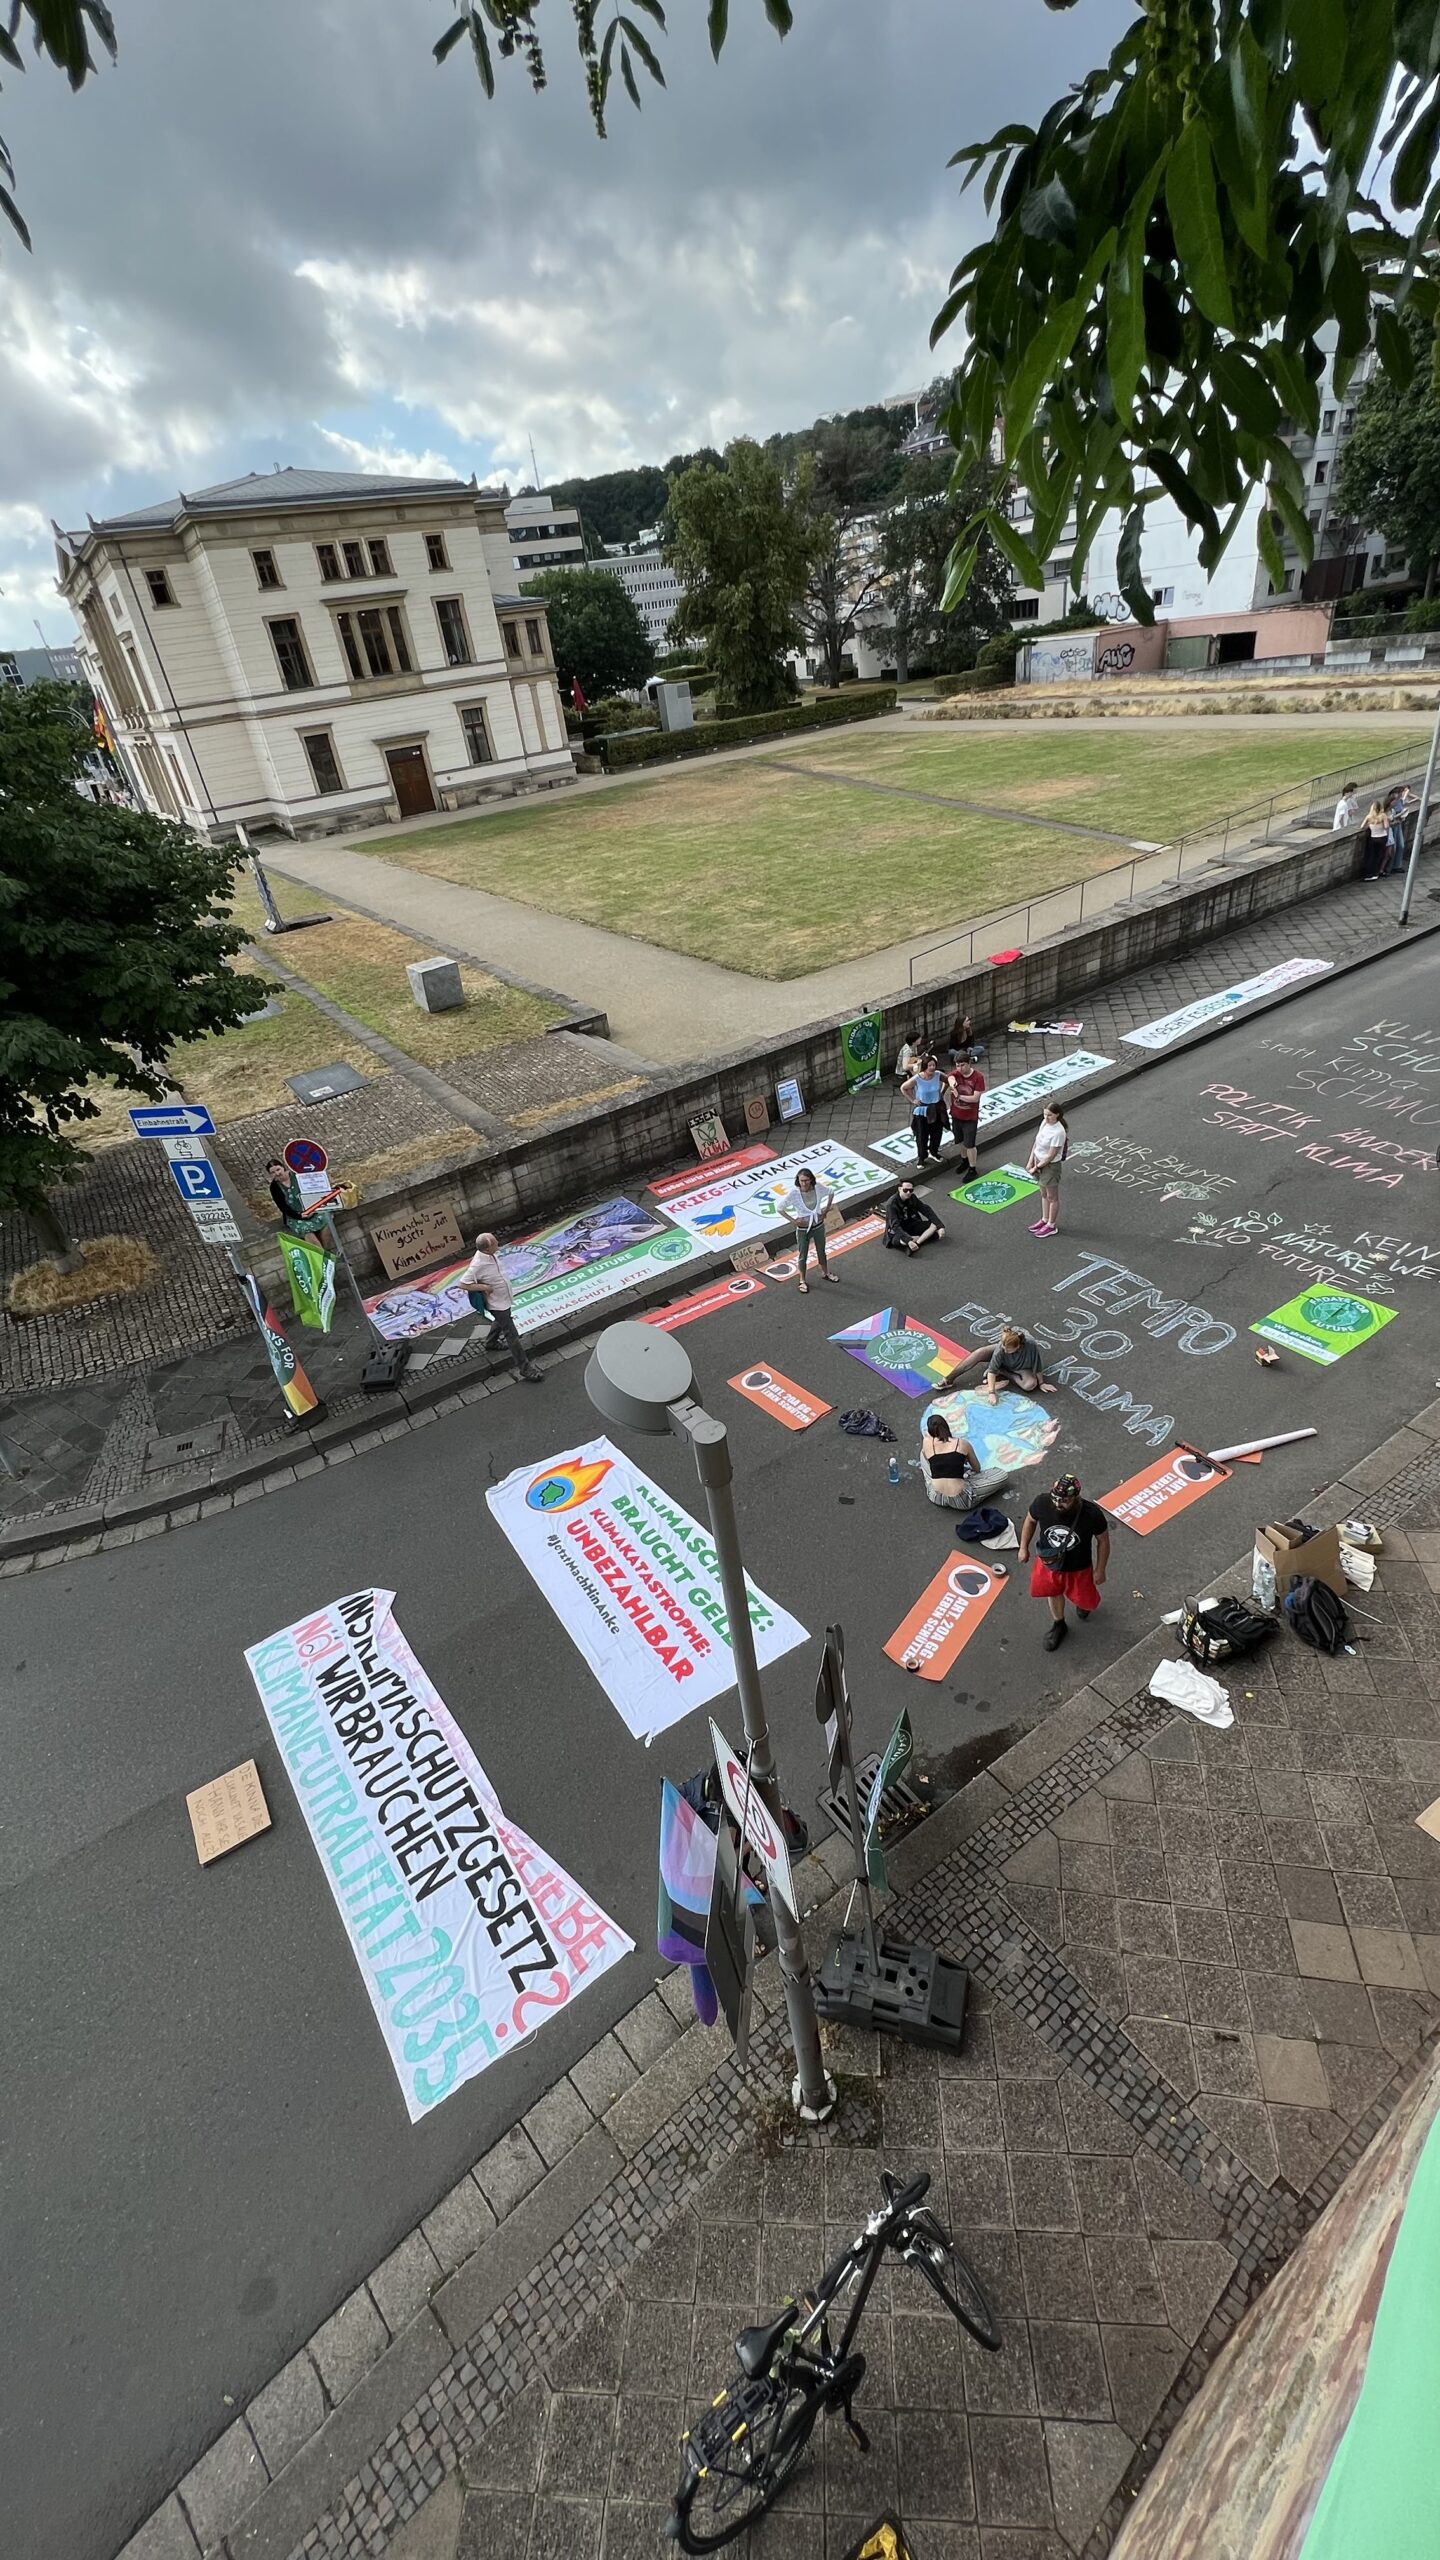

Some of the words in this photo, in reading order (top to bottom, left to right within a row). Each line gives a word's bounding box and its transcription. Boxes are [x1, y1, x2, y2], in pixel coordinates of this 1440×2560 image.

[987, 1068, 1066, 1104] FUTURE
[137, 1117, 188, 1126] Einbahnstraße
[687, 1108, 719, 1128] ESSEN
[1200, 1084, 1321, 1129] POLITIK
[1327, 1128, 1440, 1170] ÄNDER
[700, 1141, 731, 1160] KLIMA
[1202, 1111, 1297, 1141] STATT
[1296, 1143, 1403, 1188] KLIMA
[180, 1165, 206, 1194] P
[1094, 1151, 1132, 1168] FÜR
[1133, 1164, 1175, 1180] DIE
[1095, 1136, 1152, 1160] MEHR
[1153, 1155, 1237, 1194] BÄUME
[1206, 1227, 1251, 1244] NO
[1257, 1243, 1359, 1291] FUTURE
[1221, 1216, 1268, 1233] NO
[1271, 1232, 1376, 1275] NATURE
[560, 1272, 587, 1286] FOR
[588, 1252, 635, 1275] FUTURE
[553, 1291, 577, 1303] WIR
[1051, 1251, 1237, 1356] TEMPO
[1352, 1301, 1370, 1315] FOR
[880, 1330, 925, 1340] FRIDAYS
[925, 1334, 937, 1350] FOR
[1033, 1307, 1134, 1360] 30
[1310, 1319, 1355, 1332] FUTURE
[280, 1346, 295, 1370] FOR
[870, 1355, 913, 1370] FUTURE
[1043, 1355, 1175, 1447] KLIMA
[1147, 1472, 1178, 1494] LEBEN
[1163, 1479, 1188, 1495] ART.
[1130, 1506, 1149, 1519] GG
[1149, 1494, 1169, 1510] 20A
[610, 1494, 696, 1585] BRAUCHT
[589, 1508, 711, 1658] KLIMAKATASTROPHE:
[338, 1590, 374, 1638] INS
[566, 1518, 694, 1684] UNBEZAHLBAR
[931, 1592, 957, 1620] LEBEN
[946, 1596, 969, 1621] ART.
[930, 1620, 955, 1642] 20A
[918, 1641, 939, 1660] GG
[316, 1653, 367, 1718] WIR
[251, 1634, 422, 1959] KLIMANEUTRALITÄT
[334, 1702, 458, 1902] BRAUCHEN
